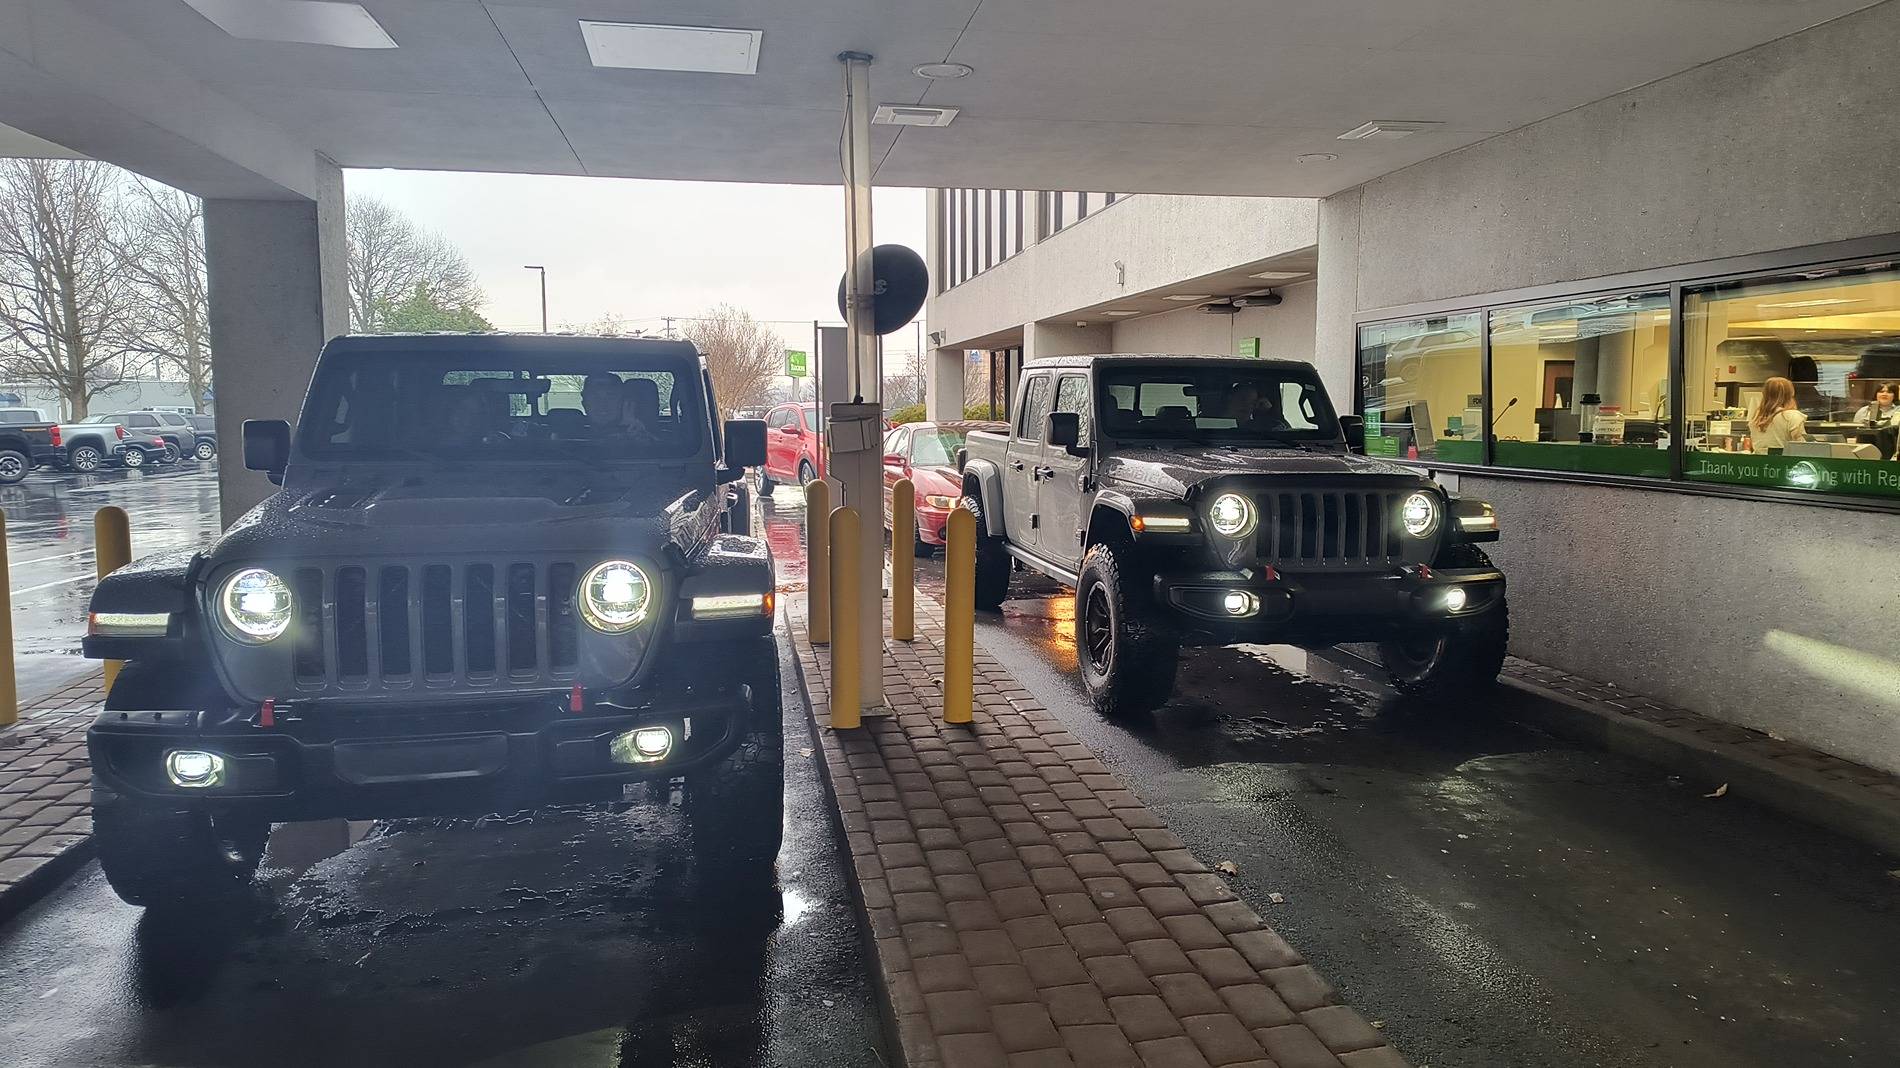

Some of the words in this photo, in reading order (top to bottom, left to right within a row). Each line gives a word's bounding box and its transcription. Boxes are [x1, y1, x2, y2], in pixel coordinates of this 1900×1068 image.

[1699, 460, 1734, 476] Thank
[1738, 466, 1759, 479] you
[1763, 463, 1781, 479] for
[1785, 464, 1838, 486] bing
[1842, 468, 1872, 485] with
